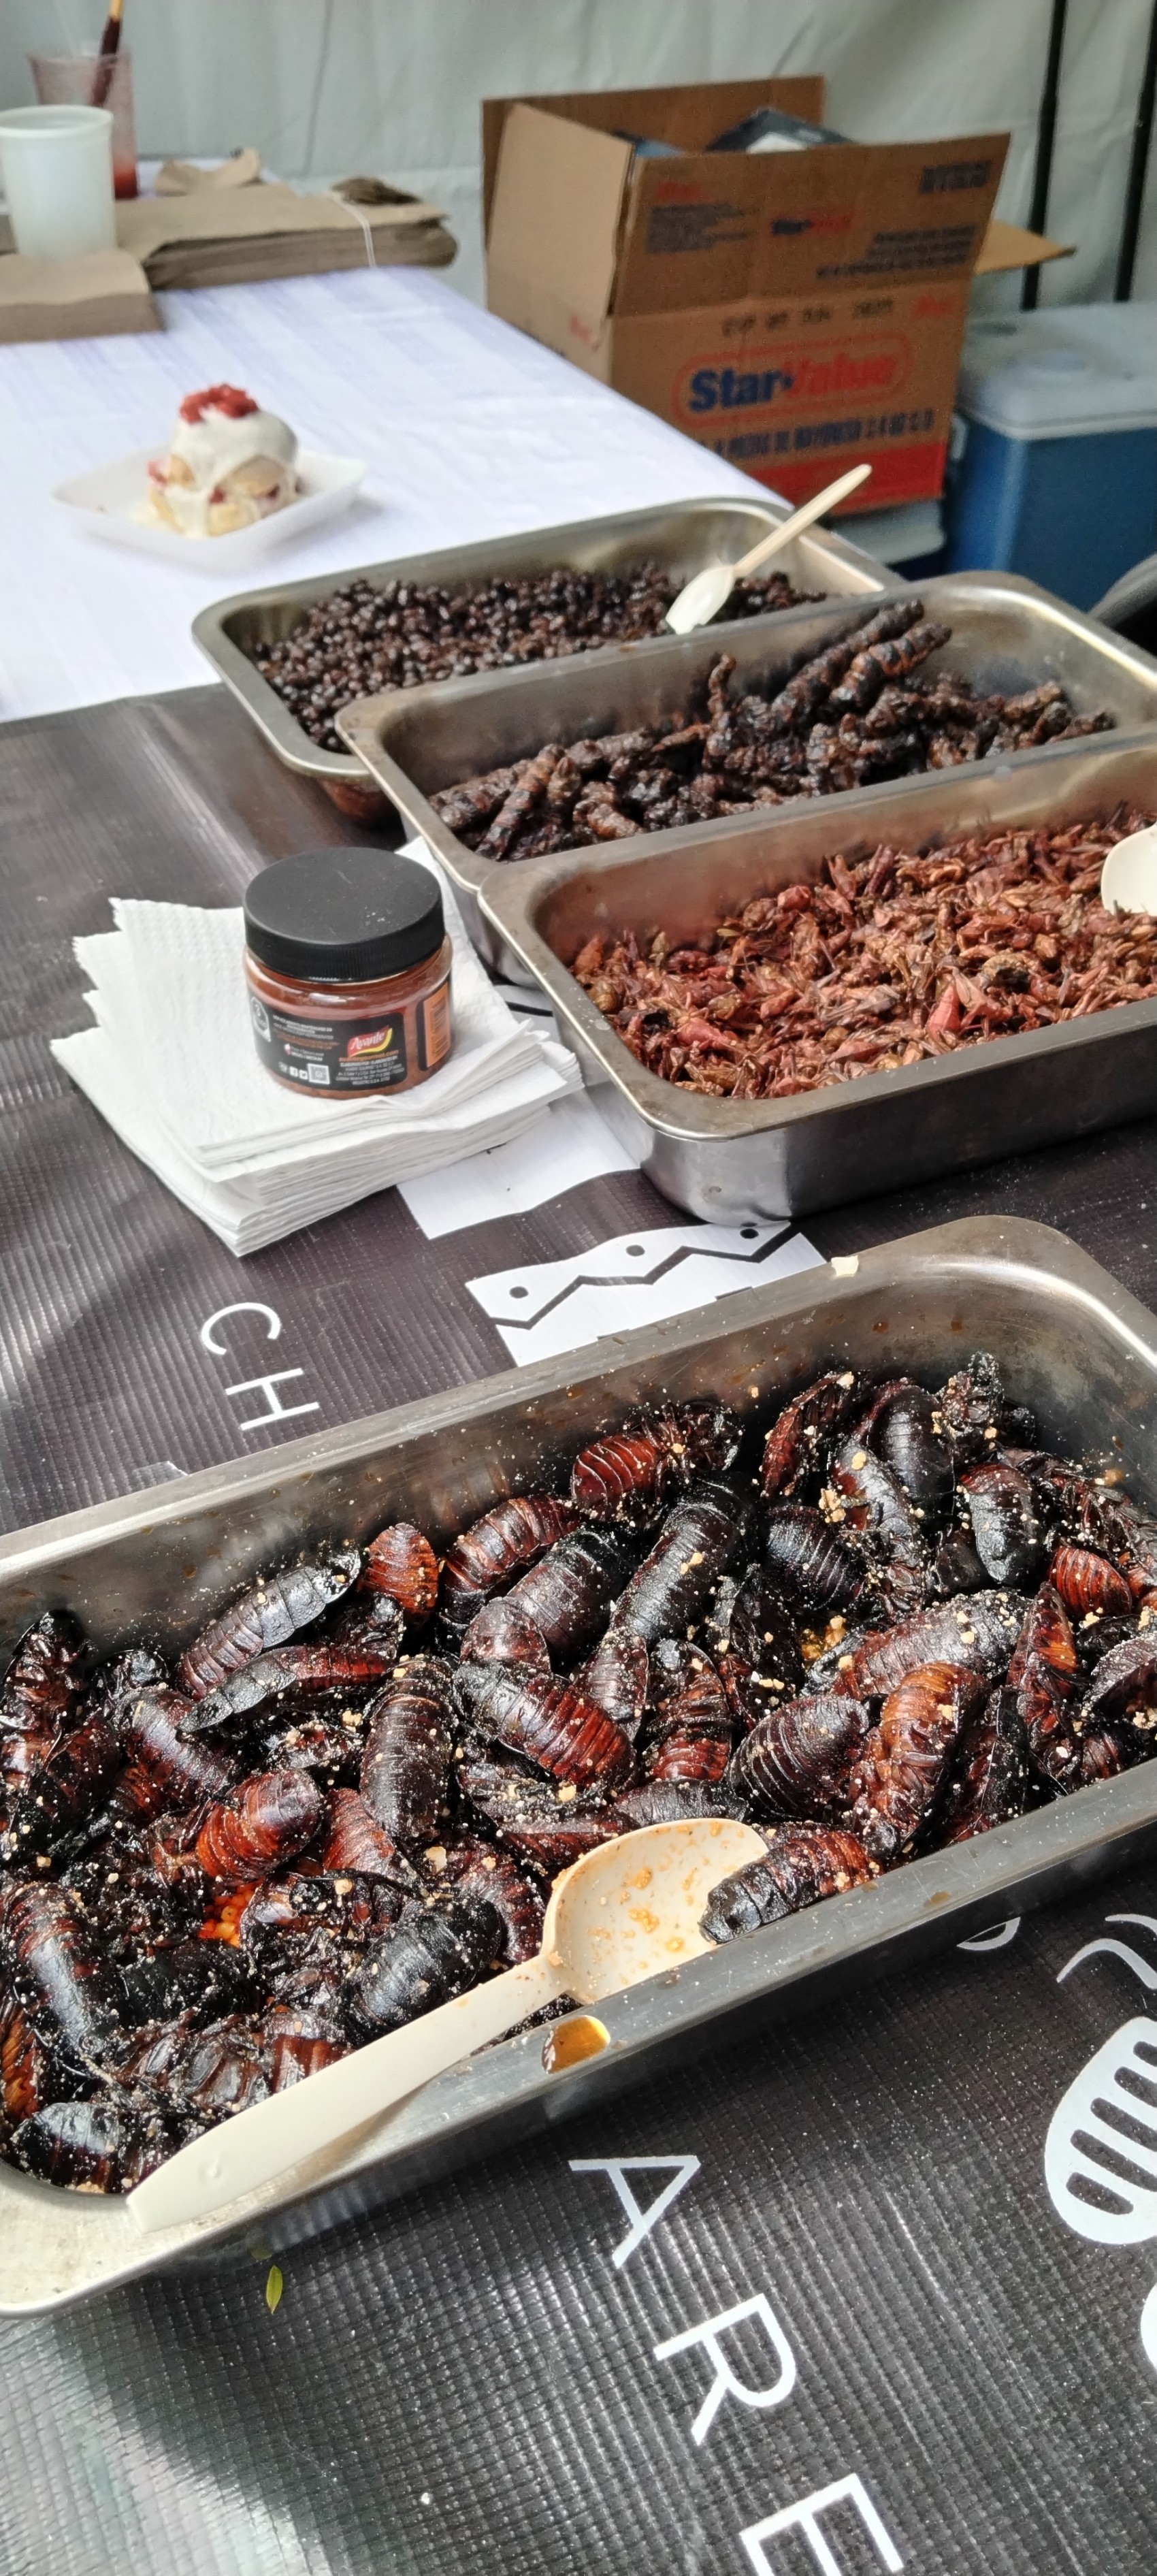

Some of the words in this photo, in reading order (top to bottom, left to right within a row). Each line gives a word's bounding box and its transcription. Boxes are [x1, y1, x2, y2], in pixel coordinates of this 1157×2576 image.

[689, 367, 785, 413] Star
[781, 352, 897, 398] Value
[349, 1031, 385, 1050] Avante
